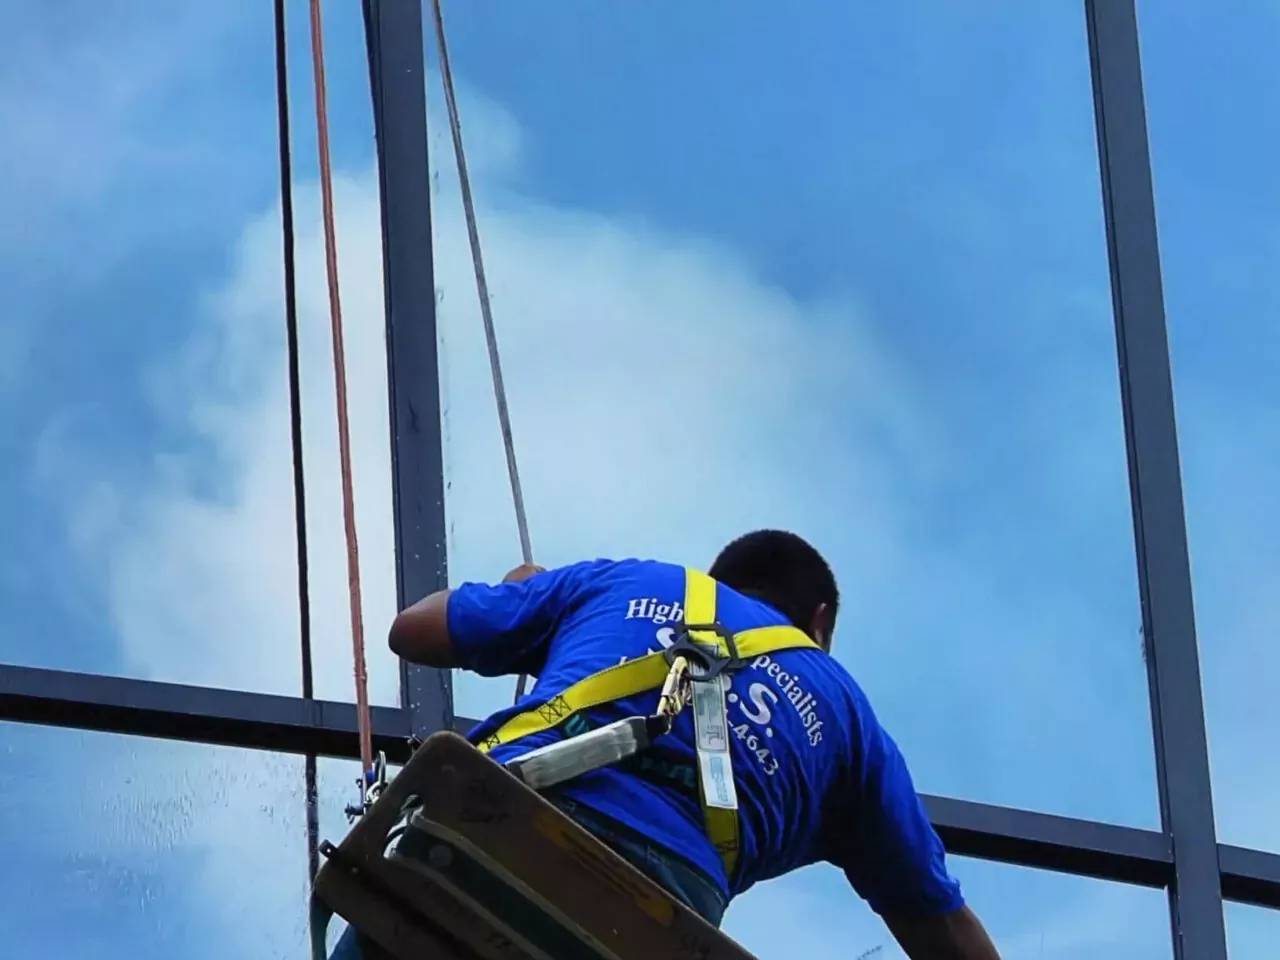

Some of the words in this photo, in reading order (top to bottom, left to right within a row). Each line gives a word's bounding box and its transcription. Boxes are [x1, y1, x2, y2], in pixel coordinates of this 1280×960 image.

[624, 598, 684, 624] High
[750, 655, 824, 747] pecialists
[726, 709, 779, 776] -4643
